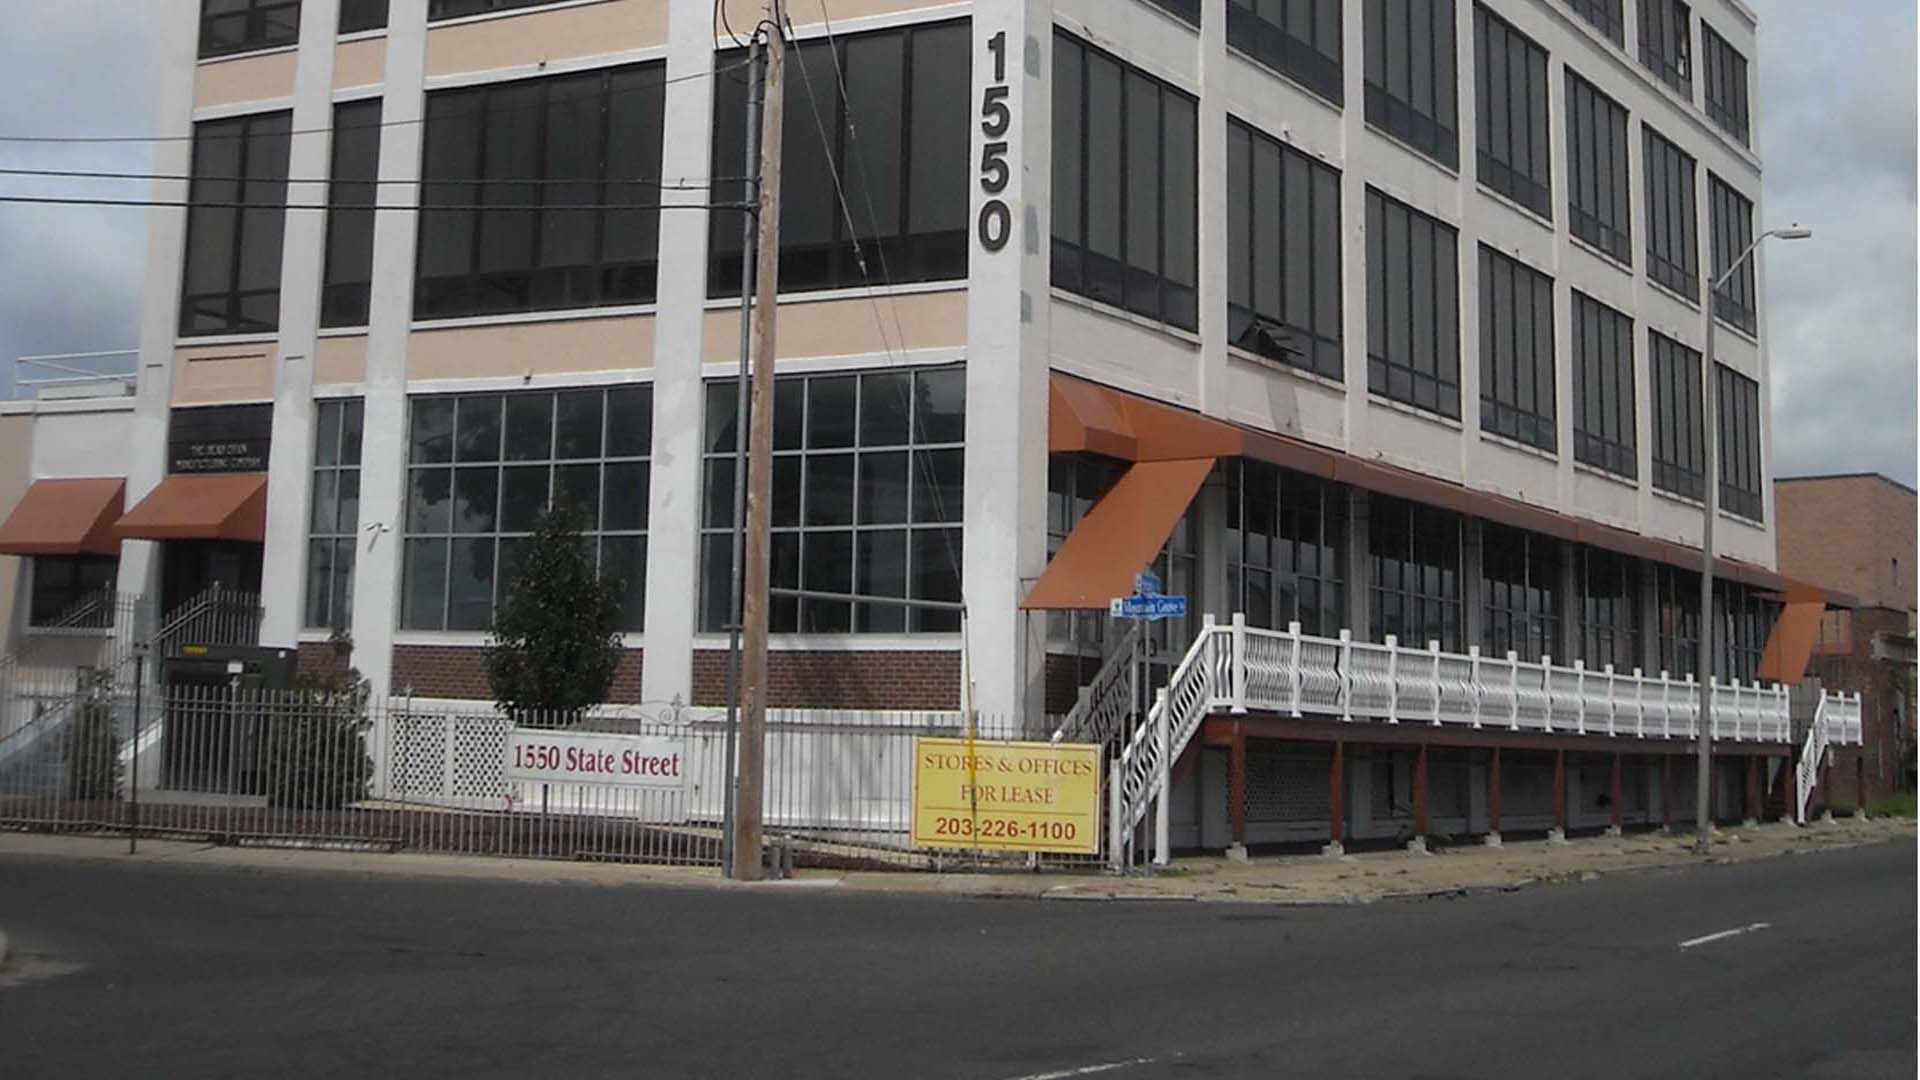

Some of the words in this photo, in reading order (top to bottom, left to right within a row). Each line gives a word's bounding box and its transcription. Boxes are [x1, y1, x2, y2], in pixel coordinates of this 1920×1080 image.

[978, 31, 1011, 252] 1550
[514, 744, 561, 770] 1550
[566, 746, 615, 774] State
[621, 749, 680, 777] Street
[925, 754, 993, 772] STORES
[998, 758, 1011, 773] &
[1019, 759, 1092, 776] OFFICES
[961, 784, 997, 801] FOR
[1001, 785, 1054, 804] LEASE
[935, 817, 1076, 840] 203-226-1100
